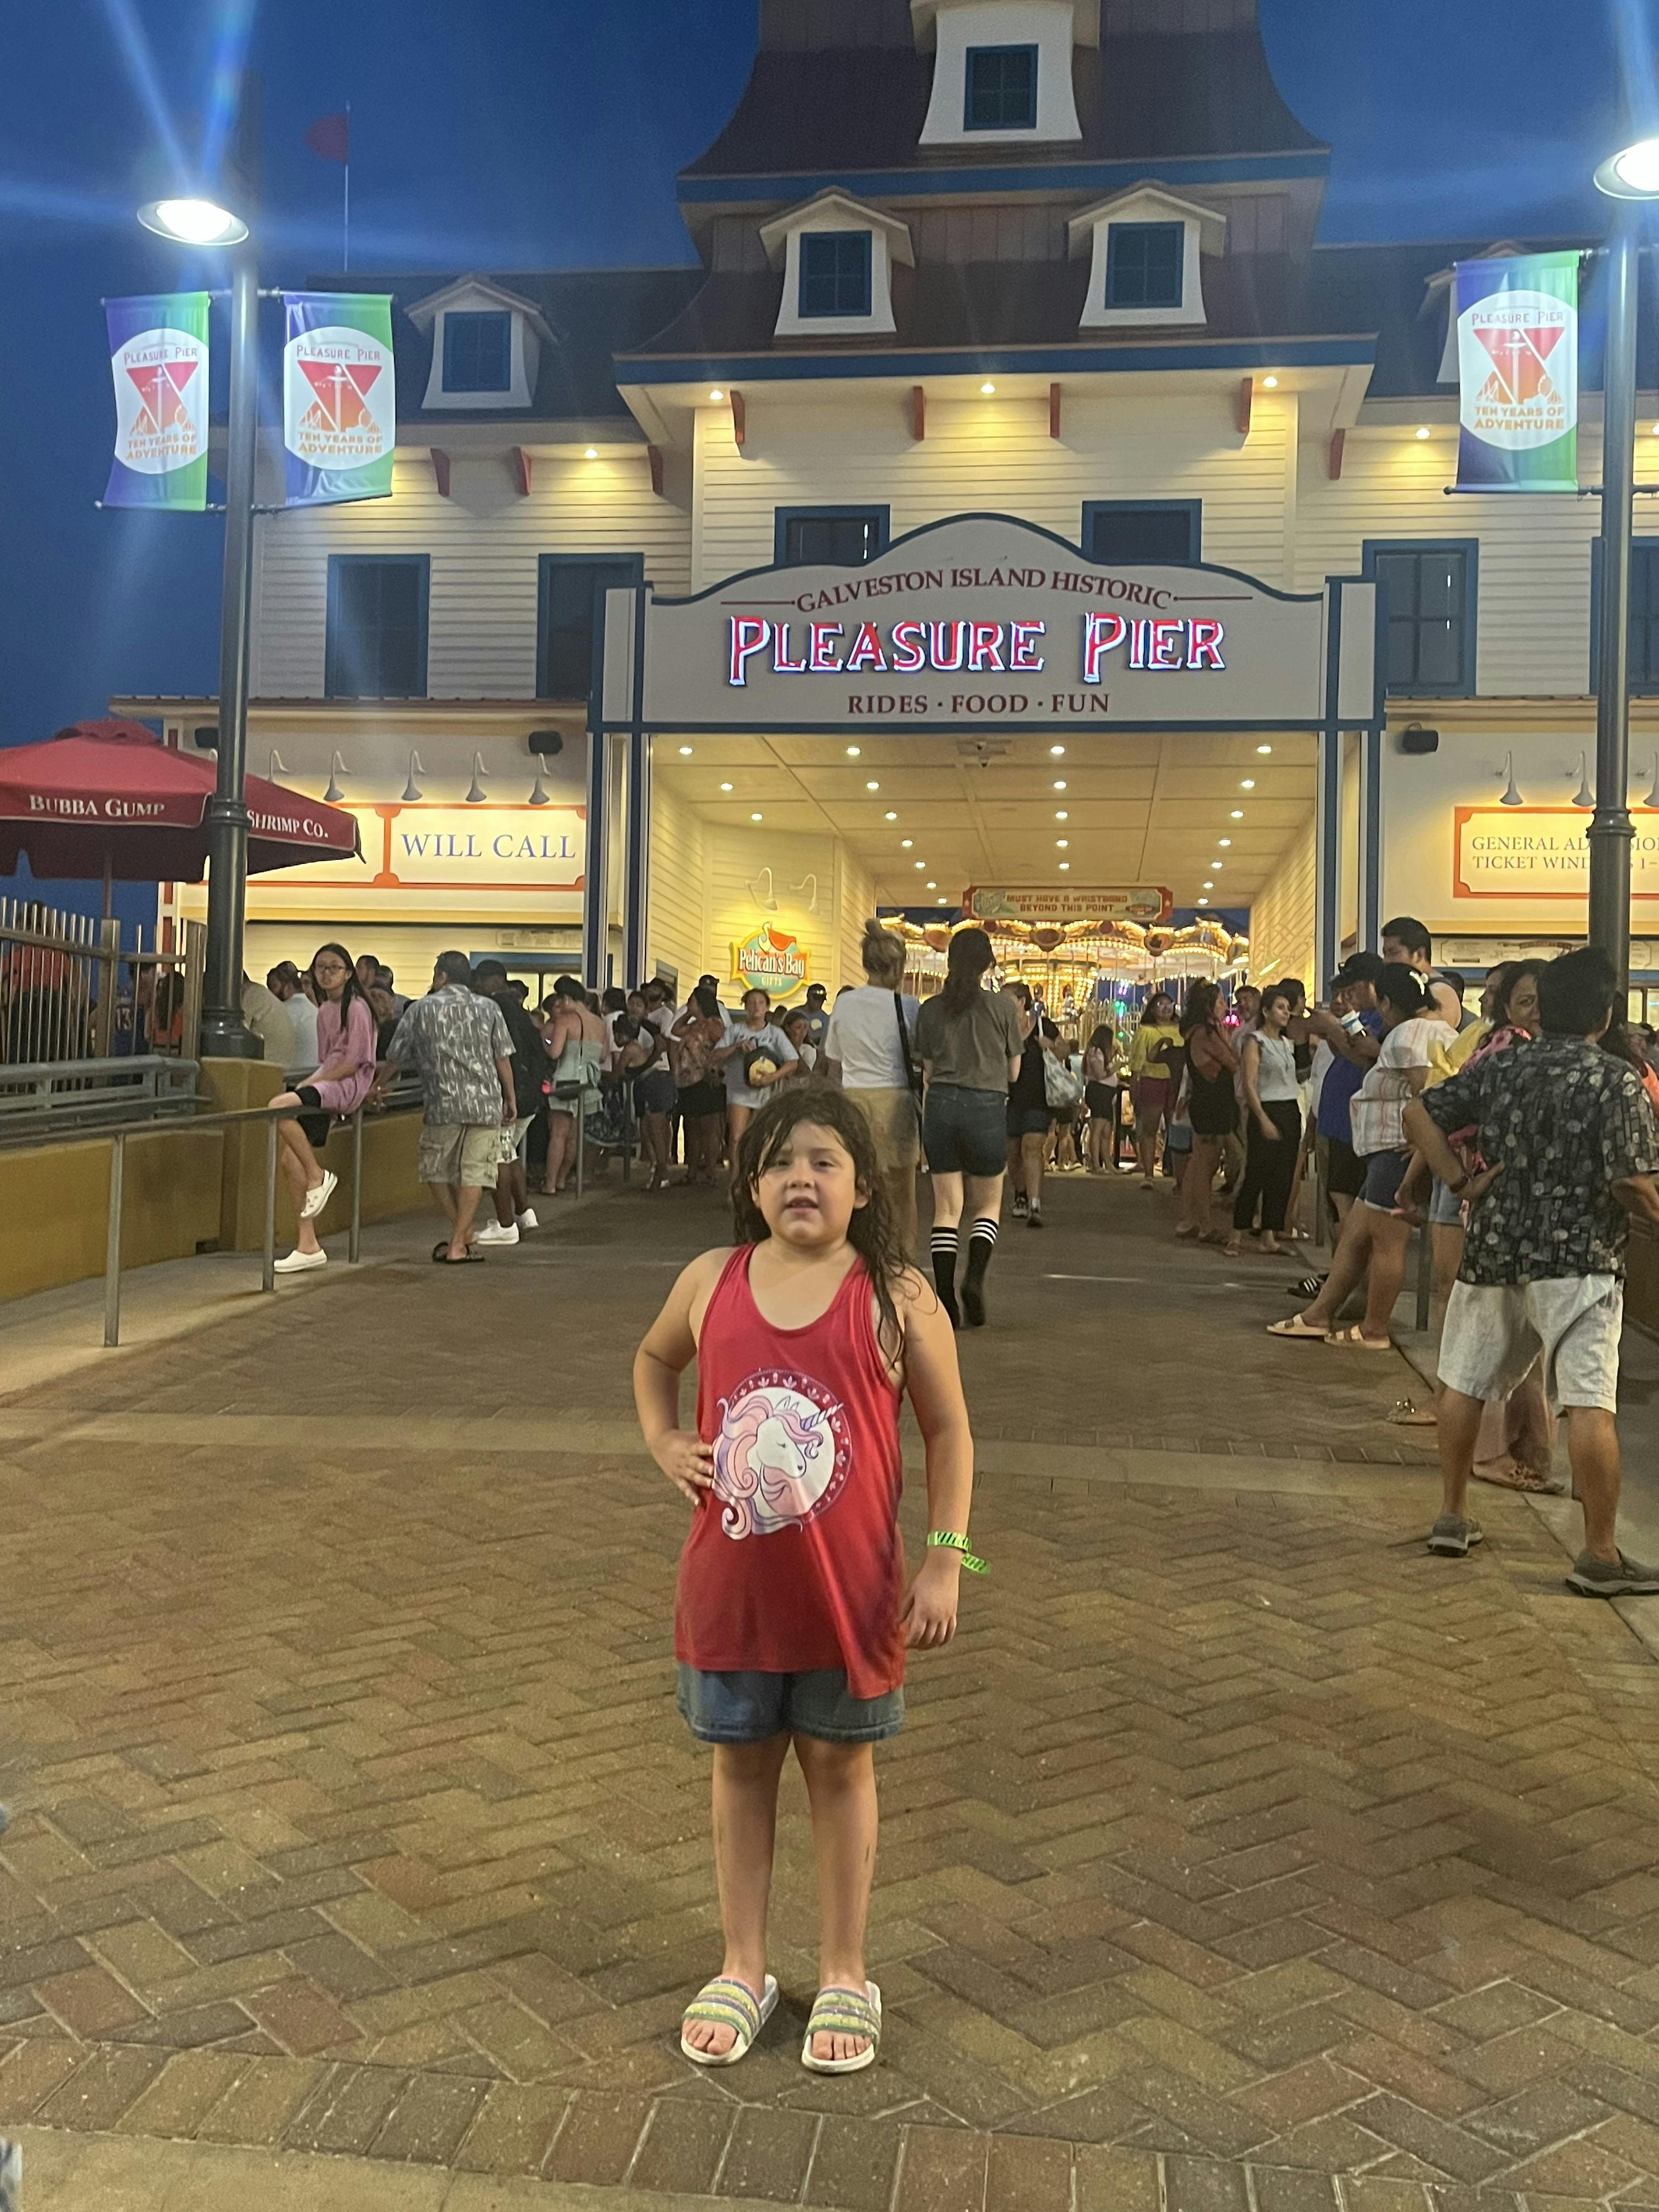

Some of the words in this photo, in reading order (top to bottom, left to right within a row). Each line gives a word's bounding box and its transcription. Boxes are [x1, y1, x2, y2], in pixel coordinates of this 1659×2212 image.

[1472, 313, 1530, 326] PLEASURE
[1538, 311, 1564, 324] PIER
[124, 349, 168, 365] PLEASURE
[176, 347, 198, 359] PIER
[297, 345, 351, 360] PLEASURE
[358, 348, 381, 362] PIER
[1475, 406, 1498, 416] TEN
[1501, 407, 1543, 417] YEARS
[1547, 407, 1565, 416] OF
[1474, 418, 1564, 430] ADVENTURE
[149, 433, 179, 446] YEARS
[182, 433, 196, 442] OF
[299, 431, 320, 442] TEN
[367, 435, 382, 444] OF
[127, 444, 196, 460] ADVENTURE
[298, 442, 382, 454] ADVENTURE
[797, 569, 943, 613] GALVESTON
[951, 568, 1046, 588] ISLAND
[1050, 571, 1171, 610] HISTORIC
[727, 614, 1046, 688] PLEASURE
[1083, 611, 1227, 685] PIER
[848, 695, 928, 714] RIDES
[952, 694, 1028, 713] FOOD
[1051, 693, 1110, 713] FUN
[29, 794, 98, 816] BUBBA
[105, 798, 165, 817] GUMP
[247, 809, 300, 834] SHRIMP
[400, 833, 482, 857] WILL
[493, 834, 576, 858] CALL
[1472, 837, 1559, 850] GENERAL
[1472, 856, 1537, 869] TICKET
[1020, 904, 1058, 912] BEYOND
[1062, 904, 1082, 912] THIS
[1086, 904, 1114, 912] POINT
[738, 949, 783, 974] Pelican's
